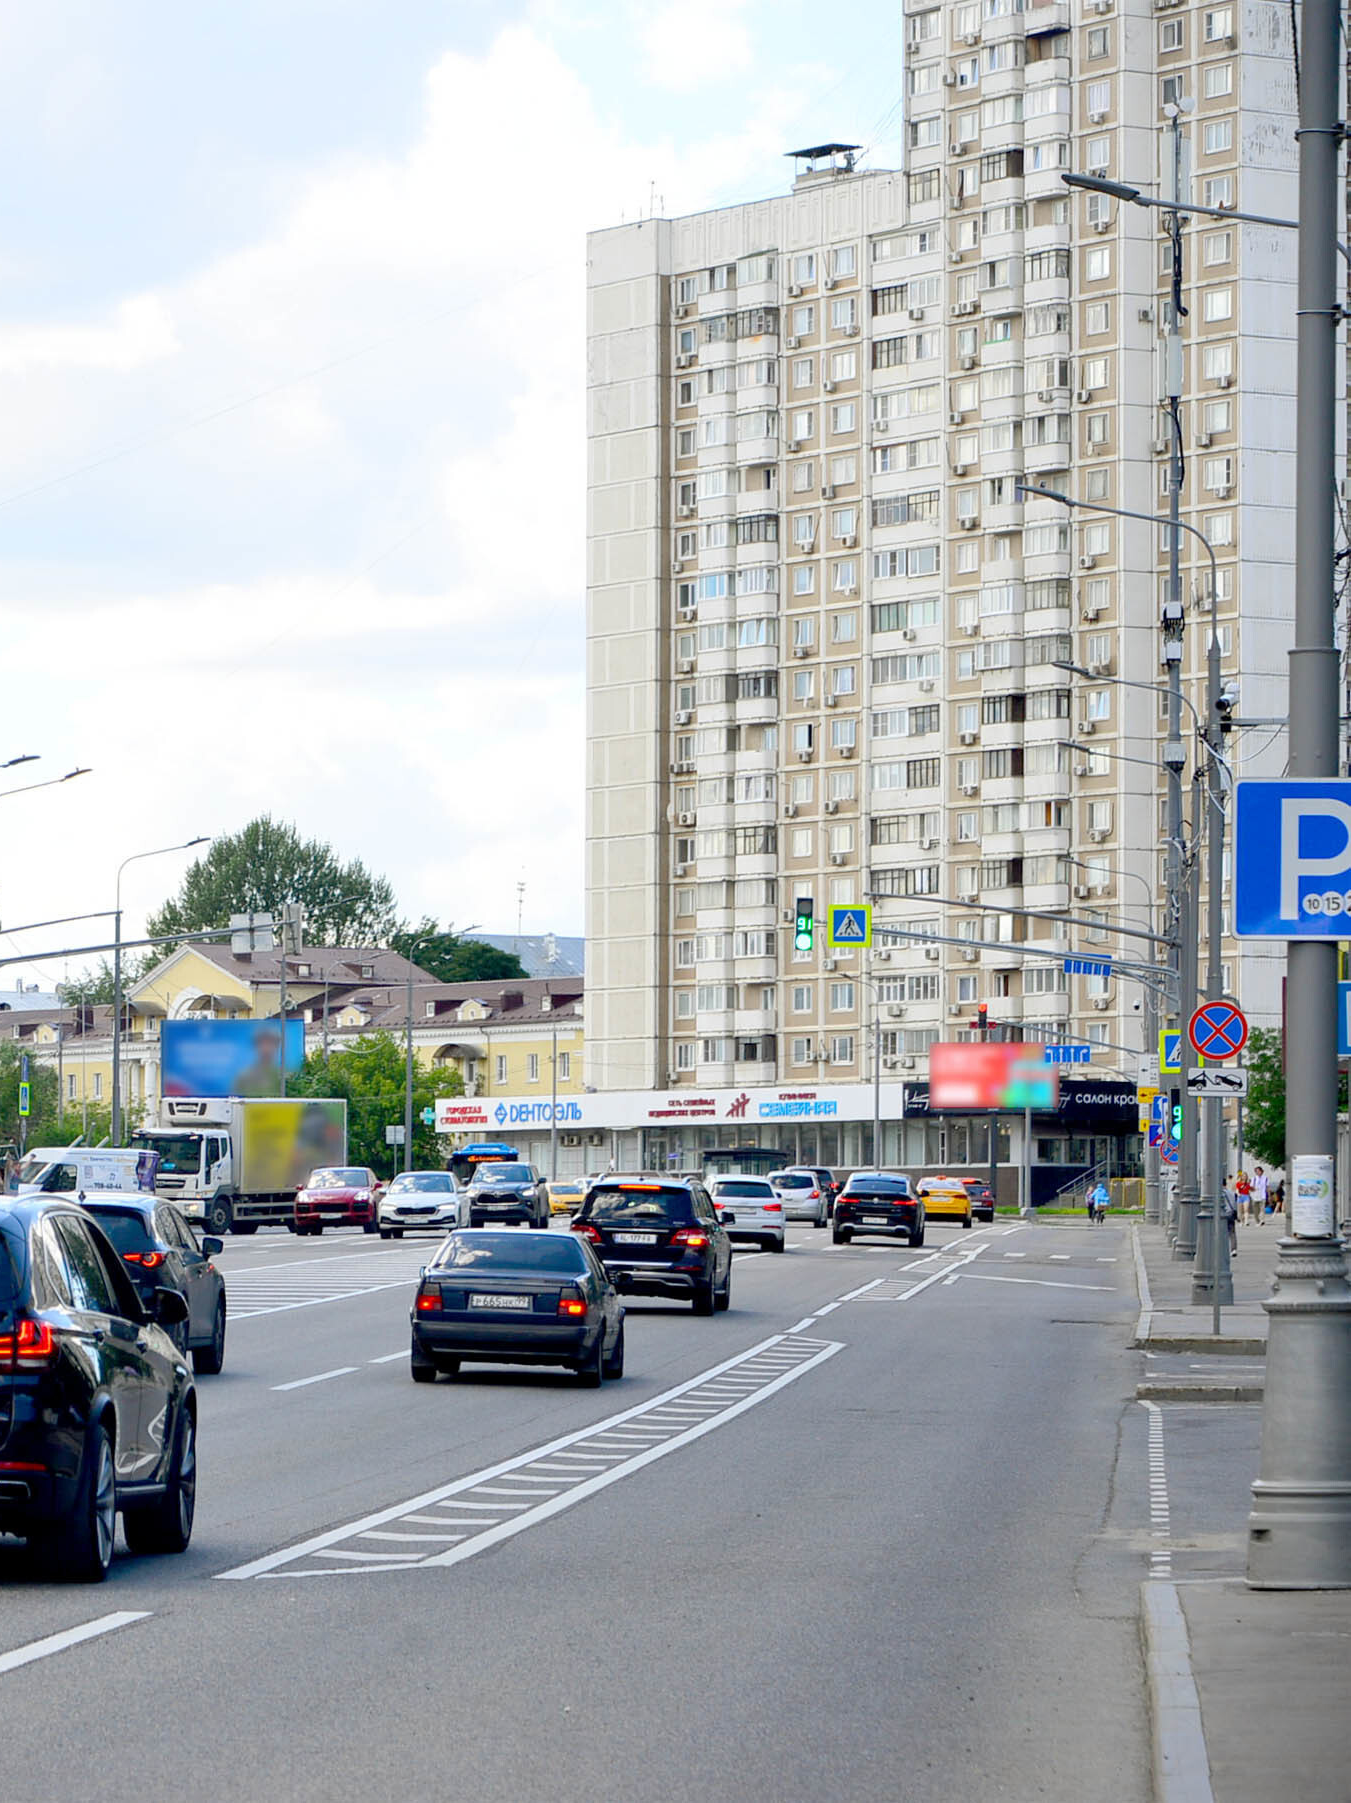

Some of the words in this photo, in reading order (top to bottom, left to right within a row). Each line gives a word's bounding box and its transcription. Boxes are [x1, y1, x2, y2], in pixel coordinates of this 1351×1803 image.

[1307, 898, 1320, 910] 10
[1325, 896, 1341, 911] 15
[797, 918, 812, 931] 91
[1075, 1094, 1112, 1104] салон
